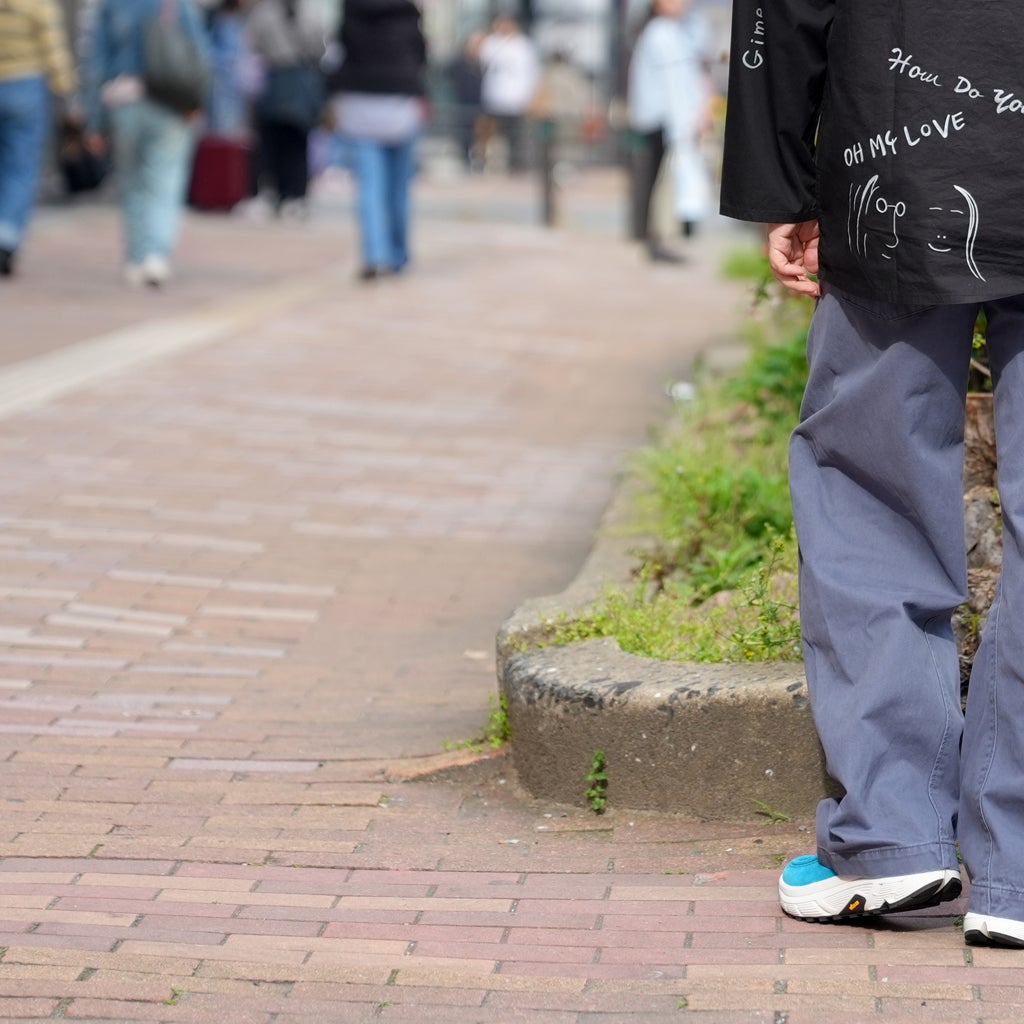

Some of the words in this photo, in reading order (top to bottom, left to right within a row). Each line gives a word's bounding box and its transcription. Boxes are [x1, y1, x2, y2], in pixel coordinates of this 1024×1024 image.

[888, 47, 942, 87] How
[953, 76, 985, 99] Do
[843, 142, 865, 167] OH
